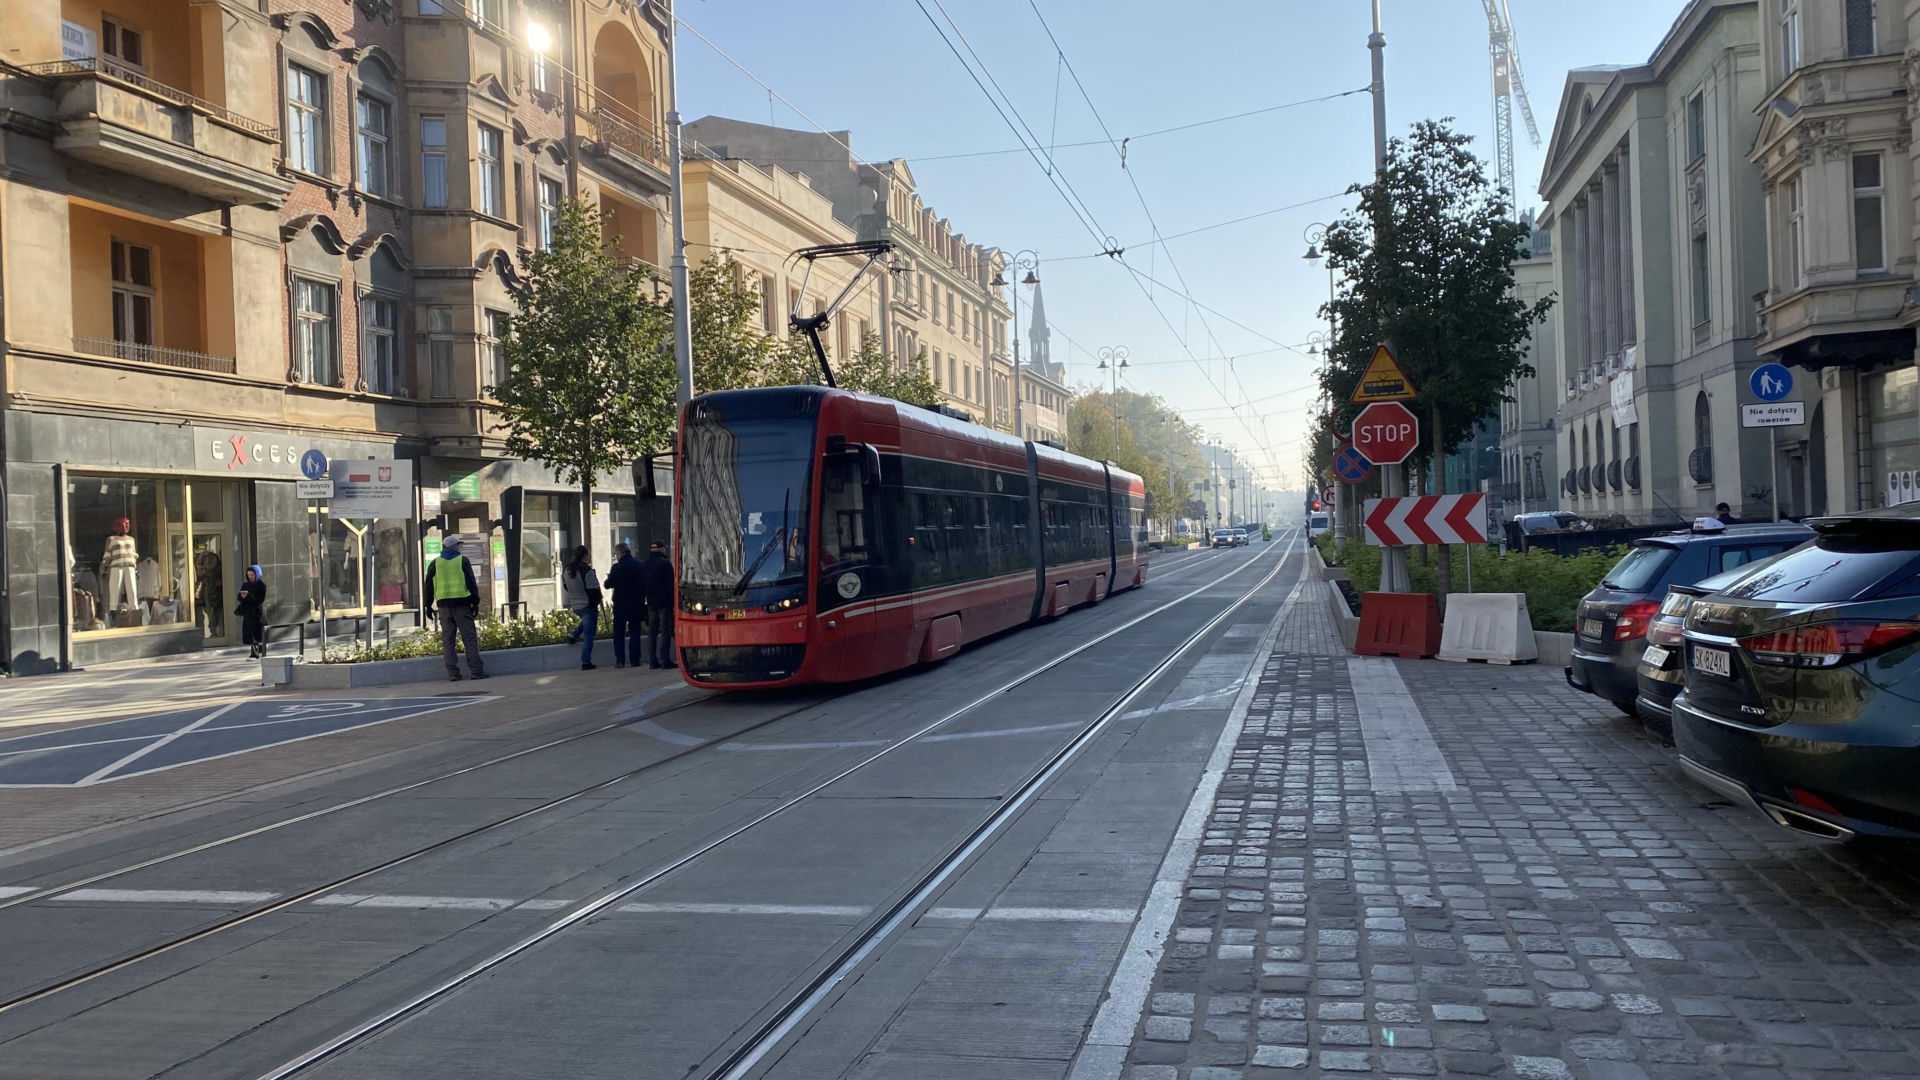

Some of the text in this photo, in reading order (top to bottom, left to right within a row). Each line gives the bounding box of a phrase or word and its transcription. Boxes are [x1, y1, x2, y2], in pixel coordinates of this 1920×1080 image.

[1768, 407, 1797, 415] dotyczy
[1361, 424, 1411, 443] STOP
[211, 434, 297, 470] EXCES
